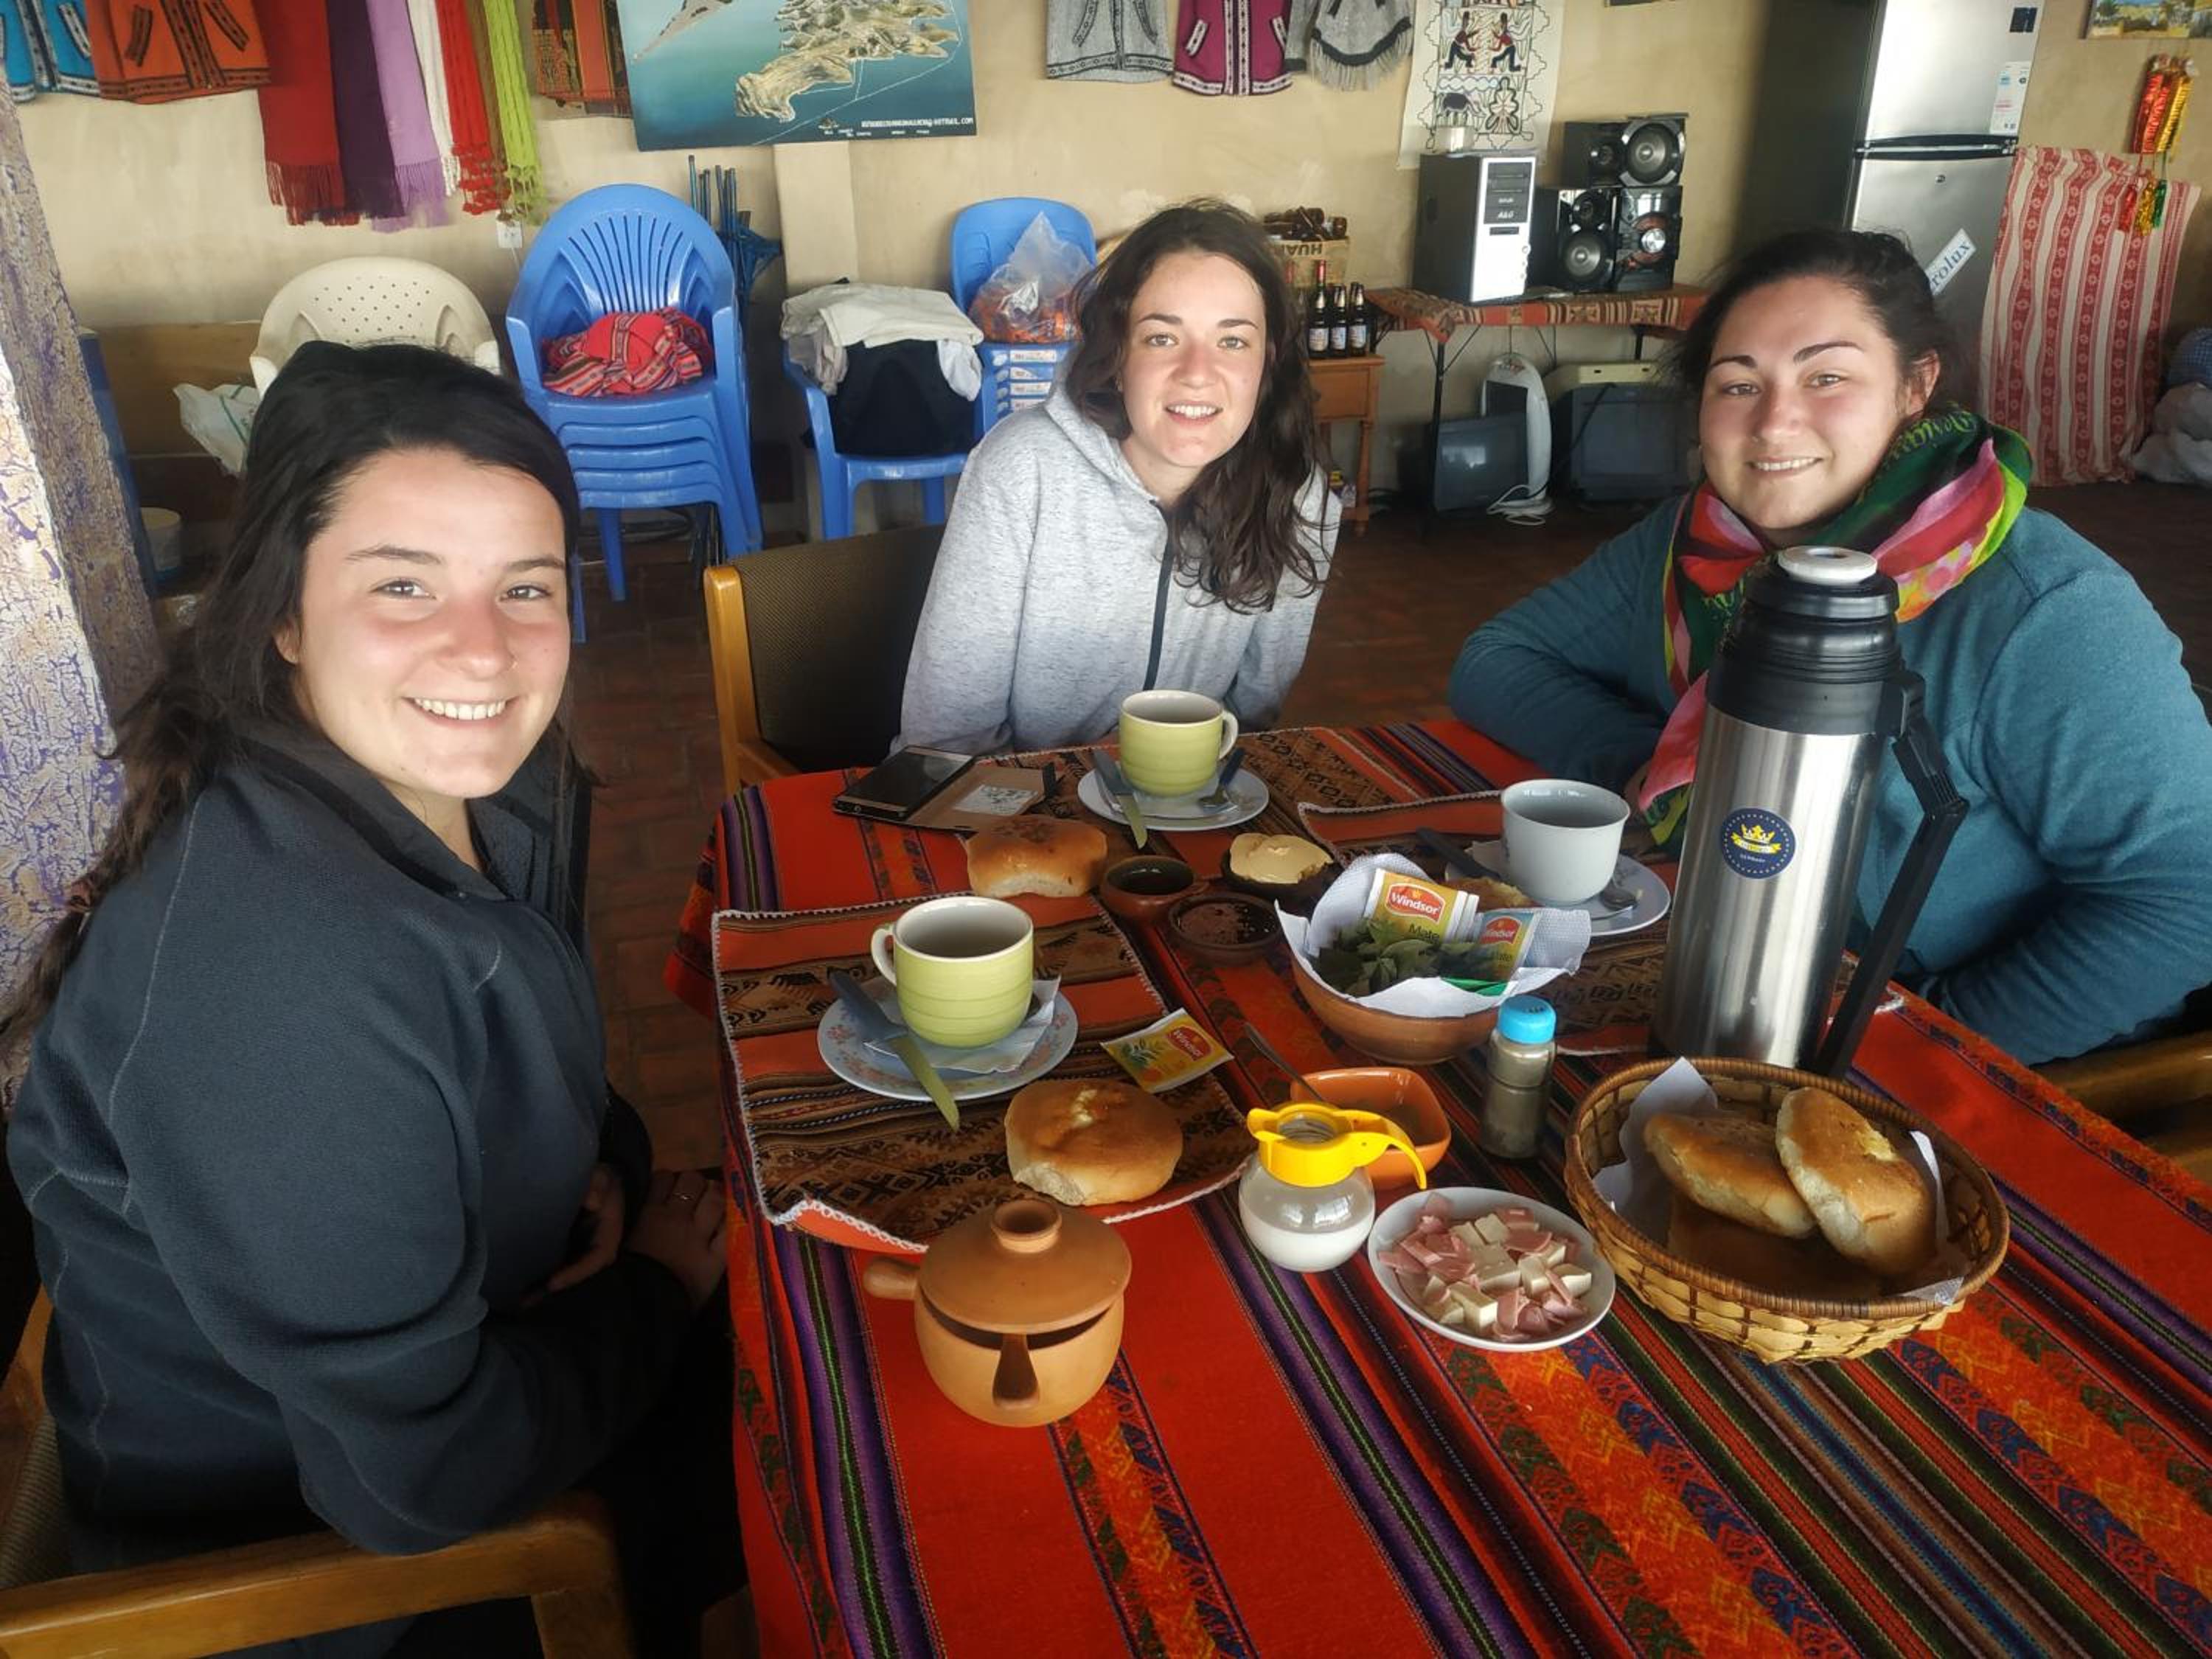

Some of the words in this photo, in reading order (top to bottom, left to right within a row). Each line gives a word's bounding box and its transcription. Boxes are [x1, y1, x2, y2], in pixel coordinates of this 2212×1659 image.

[1281, 243, 1324, 256] HUA
[1930, 242, 1970, 287] rolux
[1391, 891, 1439, 915] Windsor
[1408, 923, 1440, 942] Mate
